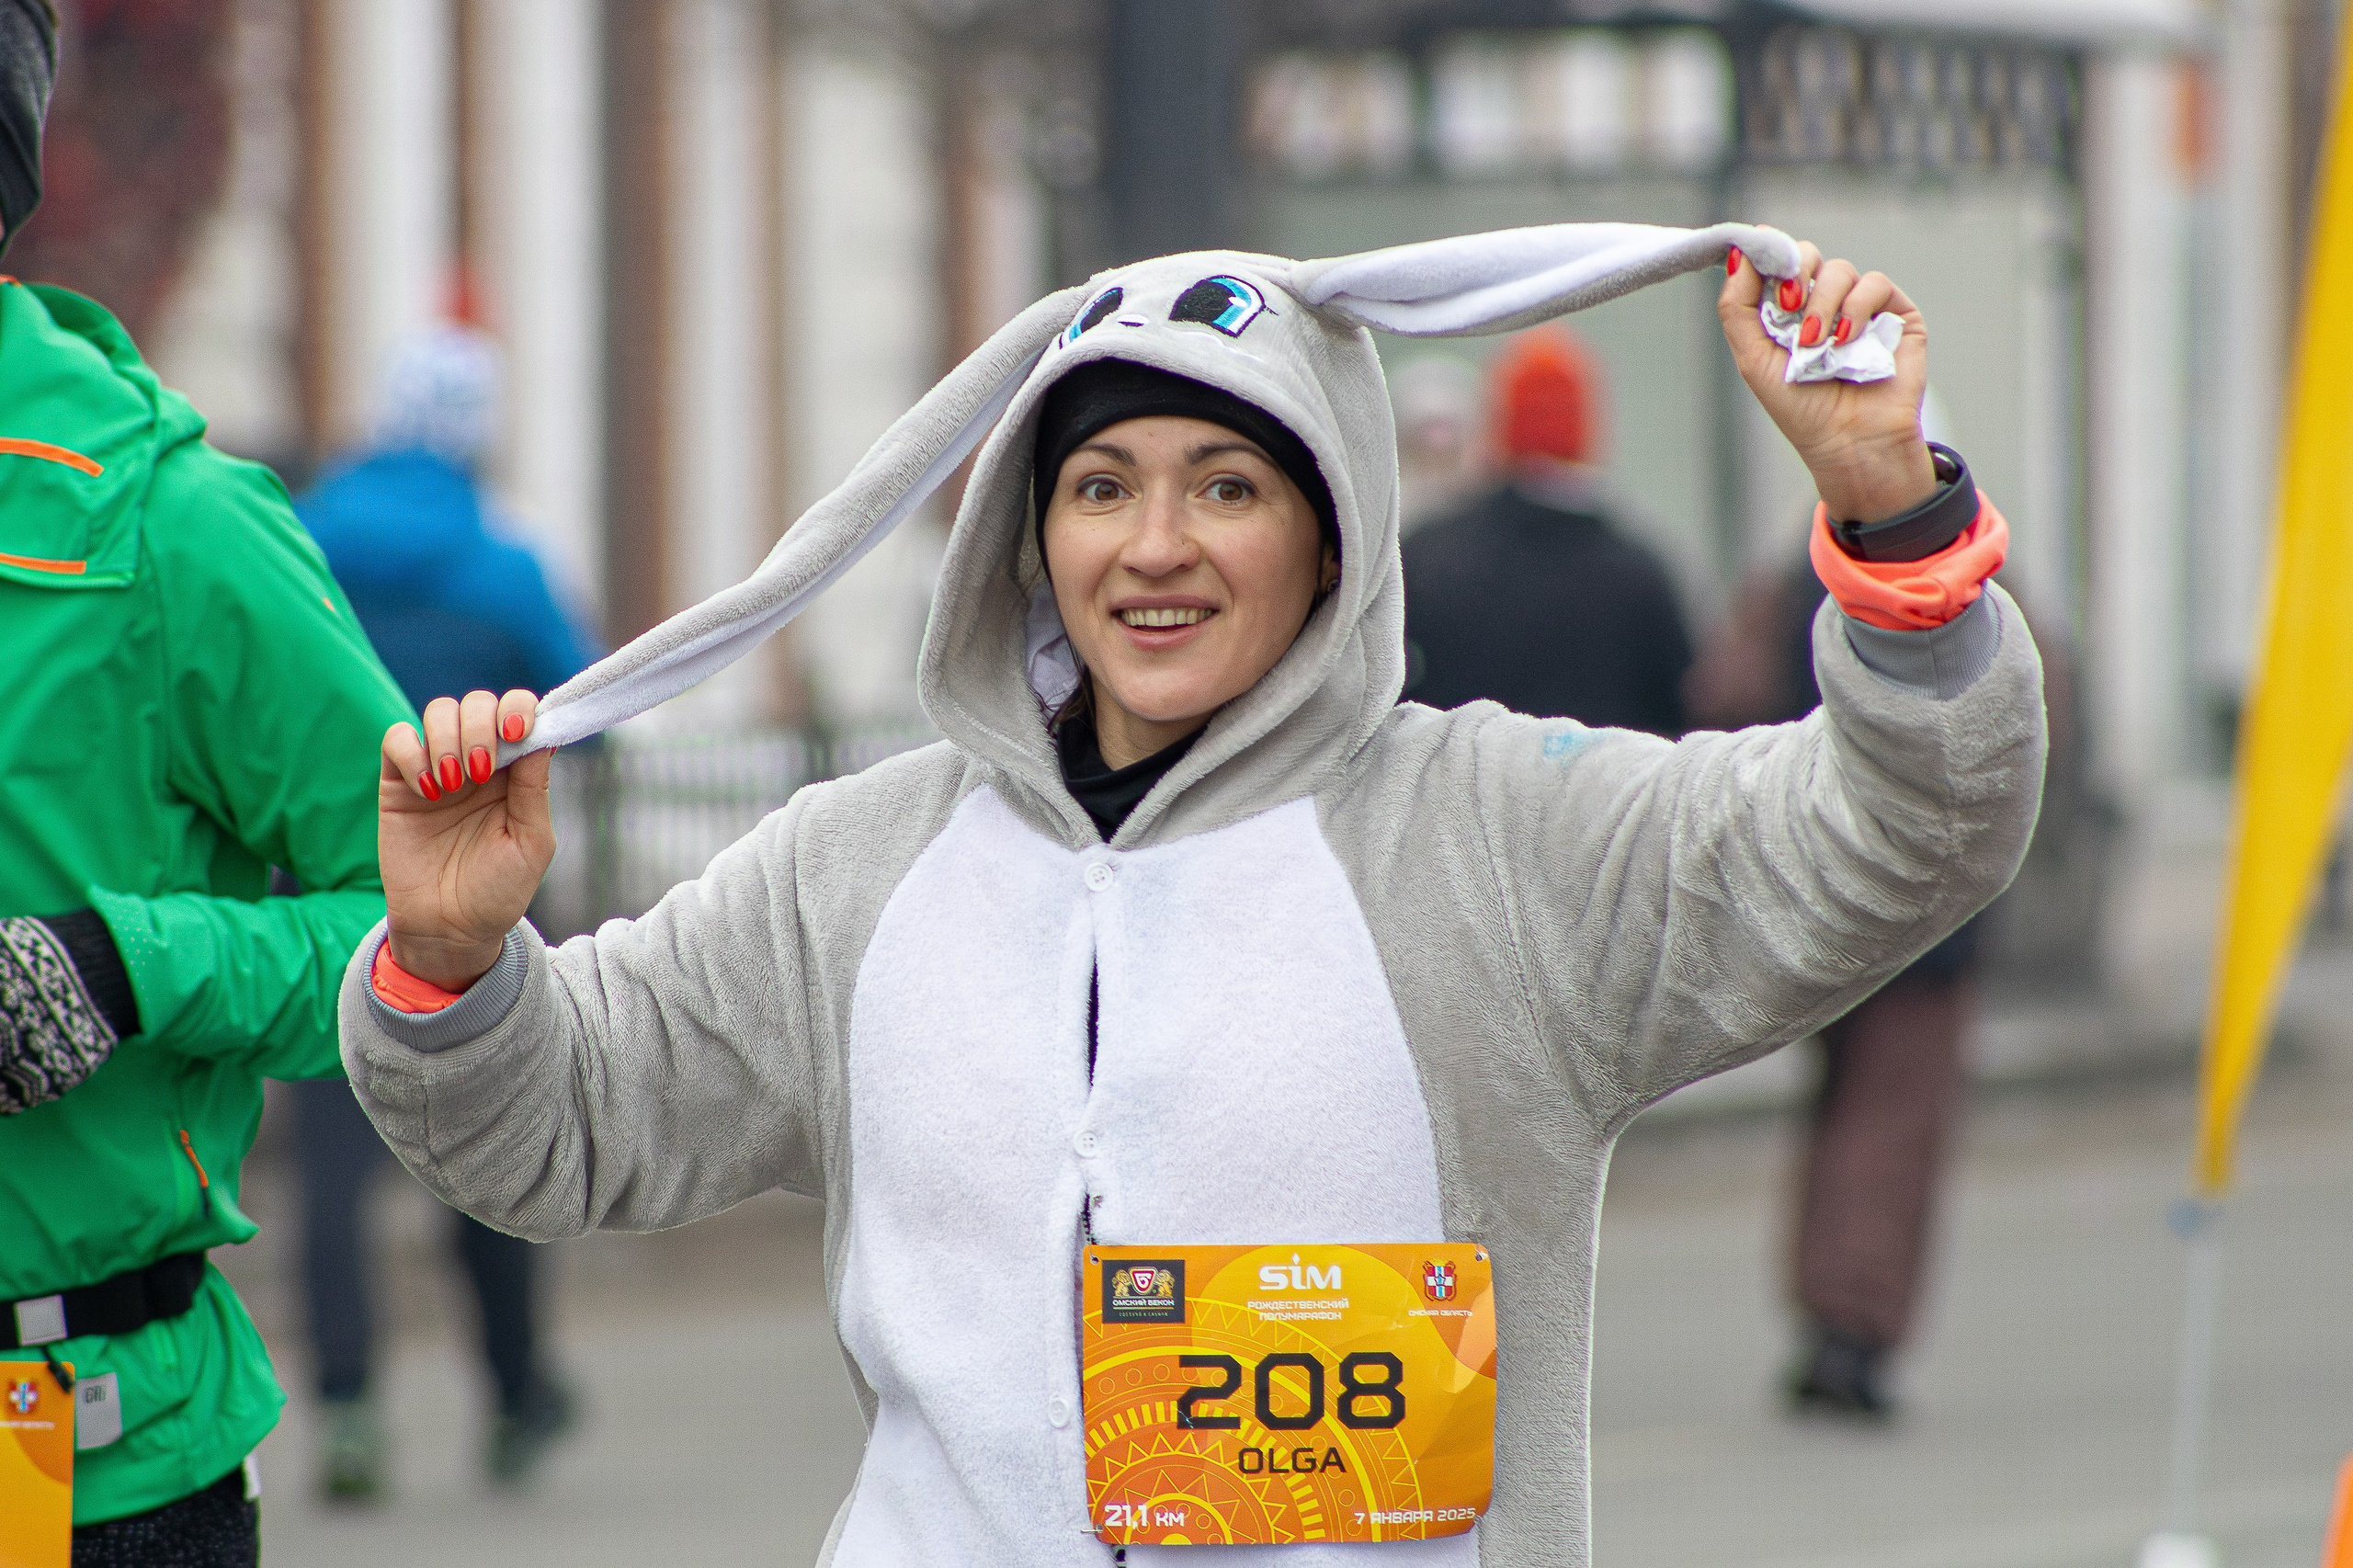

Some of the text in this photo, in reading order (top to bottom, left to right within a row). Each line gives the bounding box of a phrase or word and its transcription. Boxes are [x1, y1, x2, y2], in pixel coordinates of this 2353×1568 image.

[1247, 1297, 1349, 1311] РОЖДЕСТВЕНСКИЙ
[1258, 1312, 1342, 1321] ПОЛУМАРАФОН
[1176, 1352, 1406, 1430] 208
[1238, 1447, 1347, 1473] OLGA
[1104, 1504, 1148, 1530] 21,1
[1354, 1507, 1477, 1525] 7 ЯНВАРЯ 2025
